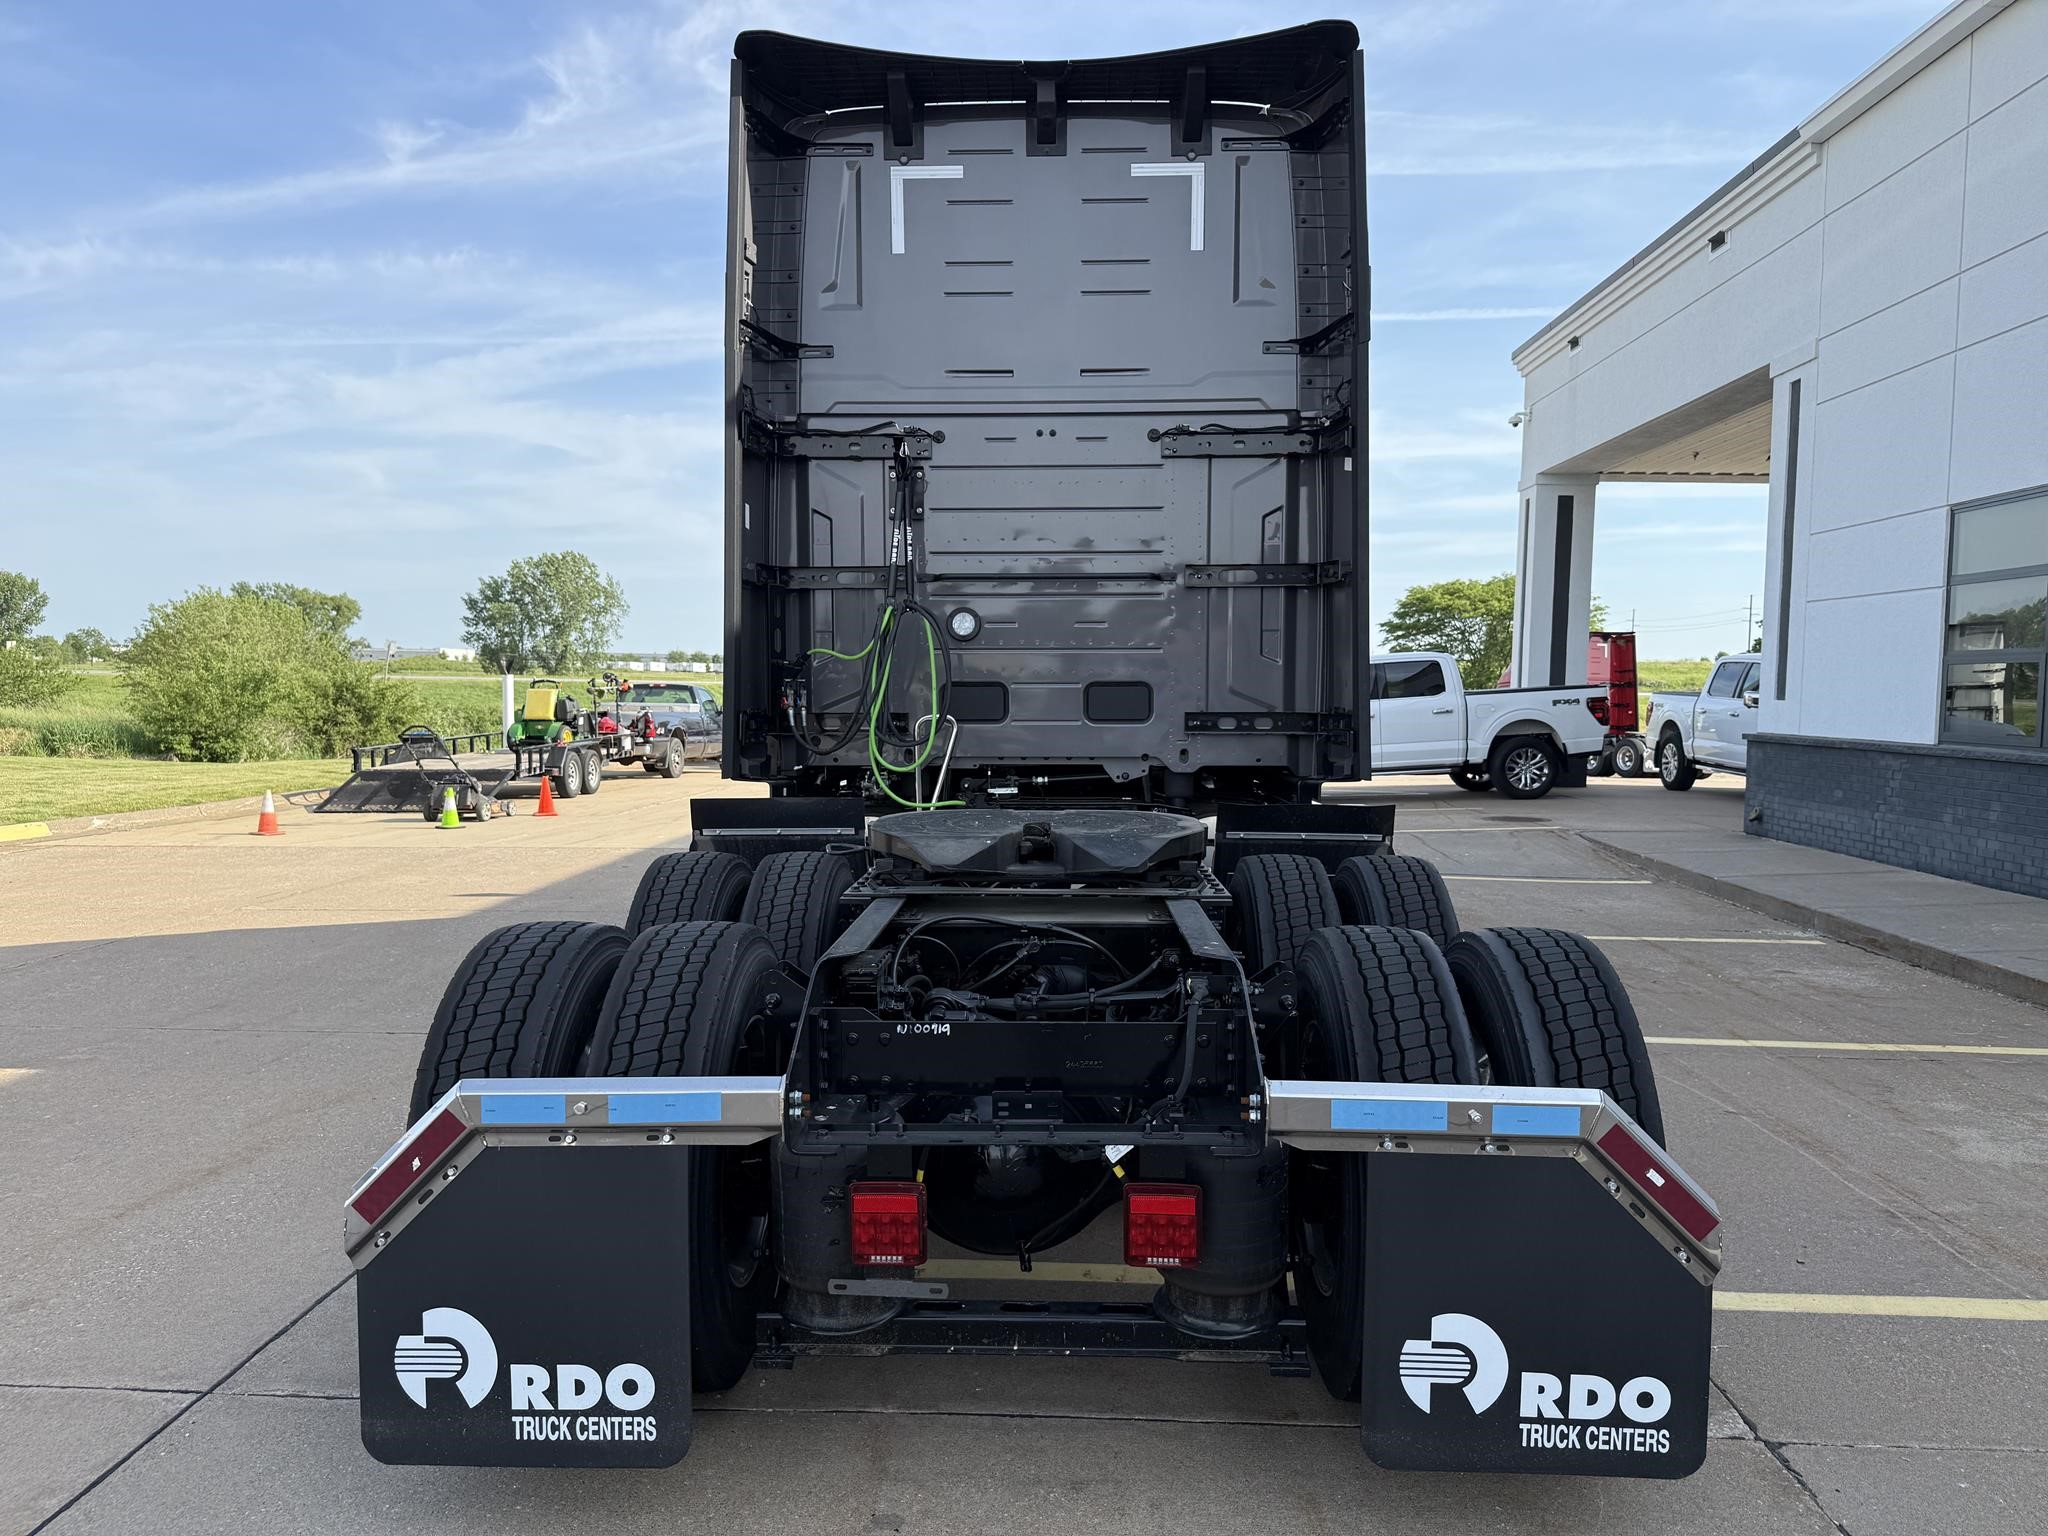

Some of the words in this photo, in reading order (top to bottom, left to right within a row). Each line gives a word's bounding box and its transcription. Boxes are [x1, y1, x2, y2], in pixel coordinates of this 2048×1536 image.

[510, 1363, 656, 1411] RDO
[1519, 1372, 1672, 1424] RDO
[512, 1416, 572, 1441] TRUCK
[575, 1416, 657, 1442] CENTERS
[1519, 1423, 1581, 1449] TRUCK
[1585, 1426, 1670, 1454] CENTERS
